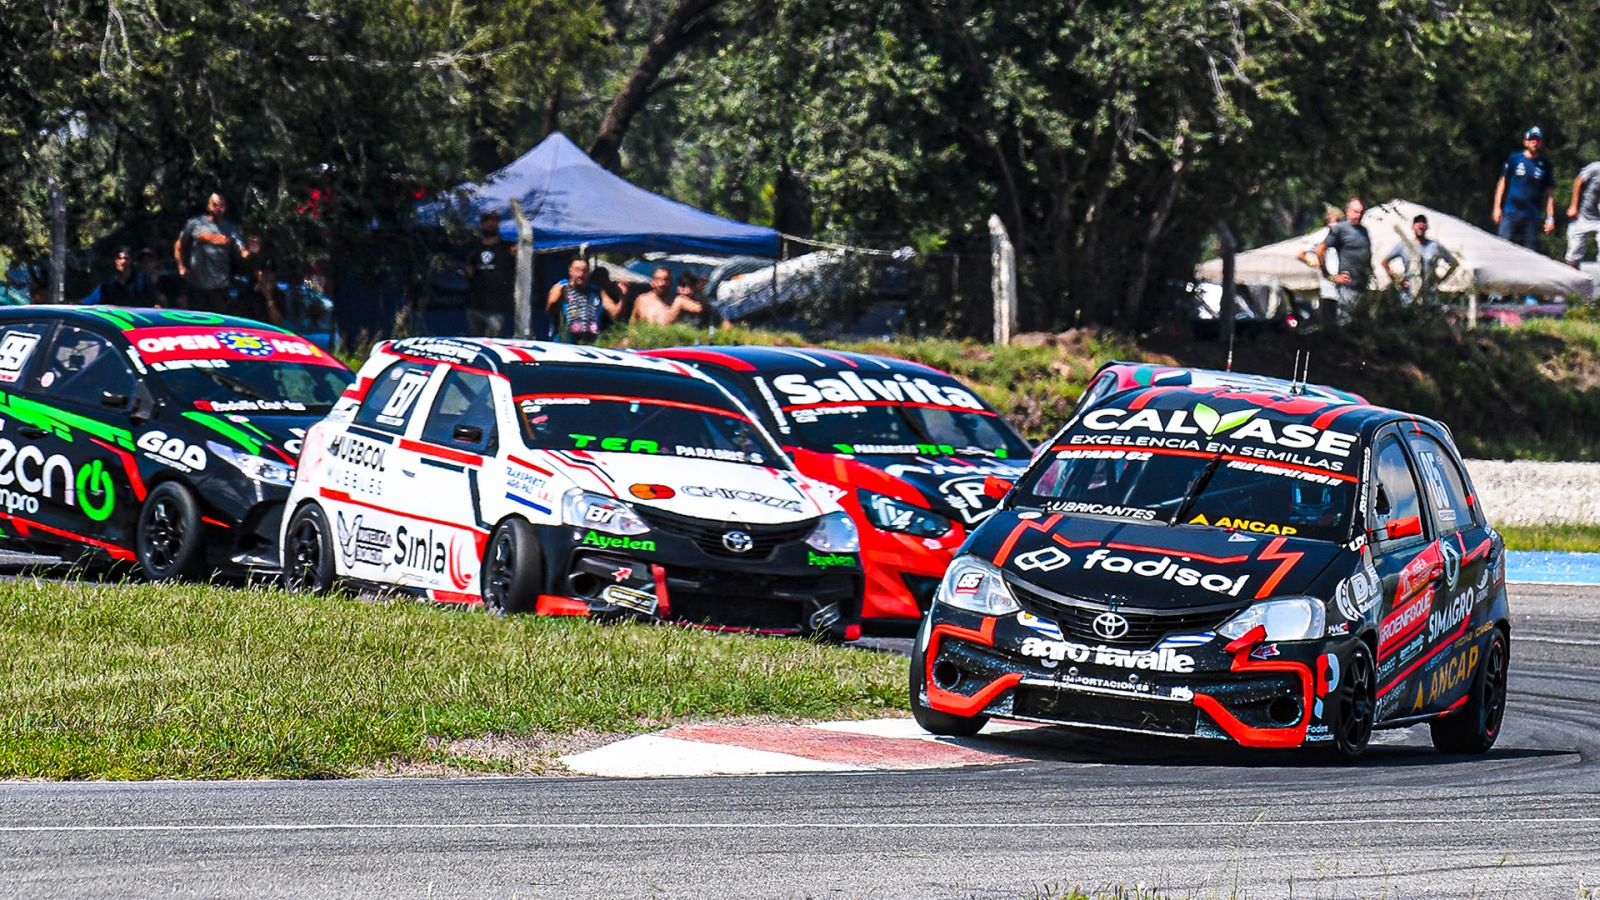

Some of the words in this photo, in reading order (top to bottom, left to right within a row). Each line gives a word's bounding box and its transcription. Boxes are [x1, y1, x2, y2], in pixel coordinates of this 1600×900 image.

[138, 334, 221, 353] OPEN
[773, 371, 985, 410] Salvita
[1070, 434, 1200, 451] EXCELENCIA
[1205, 441, 1235, 455] EN
[1239, 445, 1345, 472] SEMILLAS
[582, 530, 656, 552] Ayelen
[1216, 516, 1298, 536] ANCAP
[1083, 549, 1250, 597] fadisol
[1428, 586, 1474, 643] SIMAGRO
[1021, 637, 1090, 668] agro
[1062, 674, 1150, 692] IMPORTACIONES
[1427, 645, 1479, 705] ANCAP
